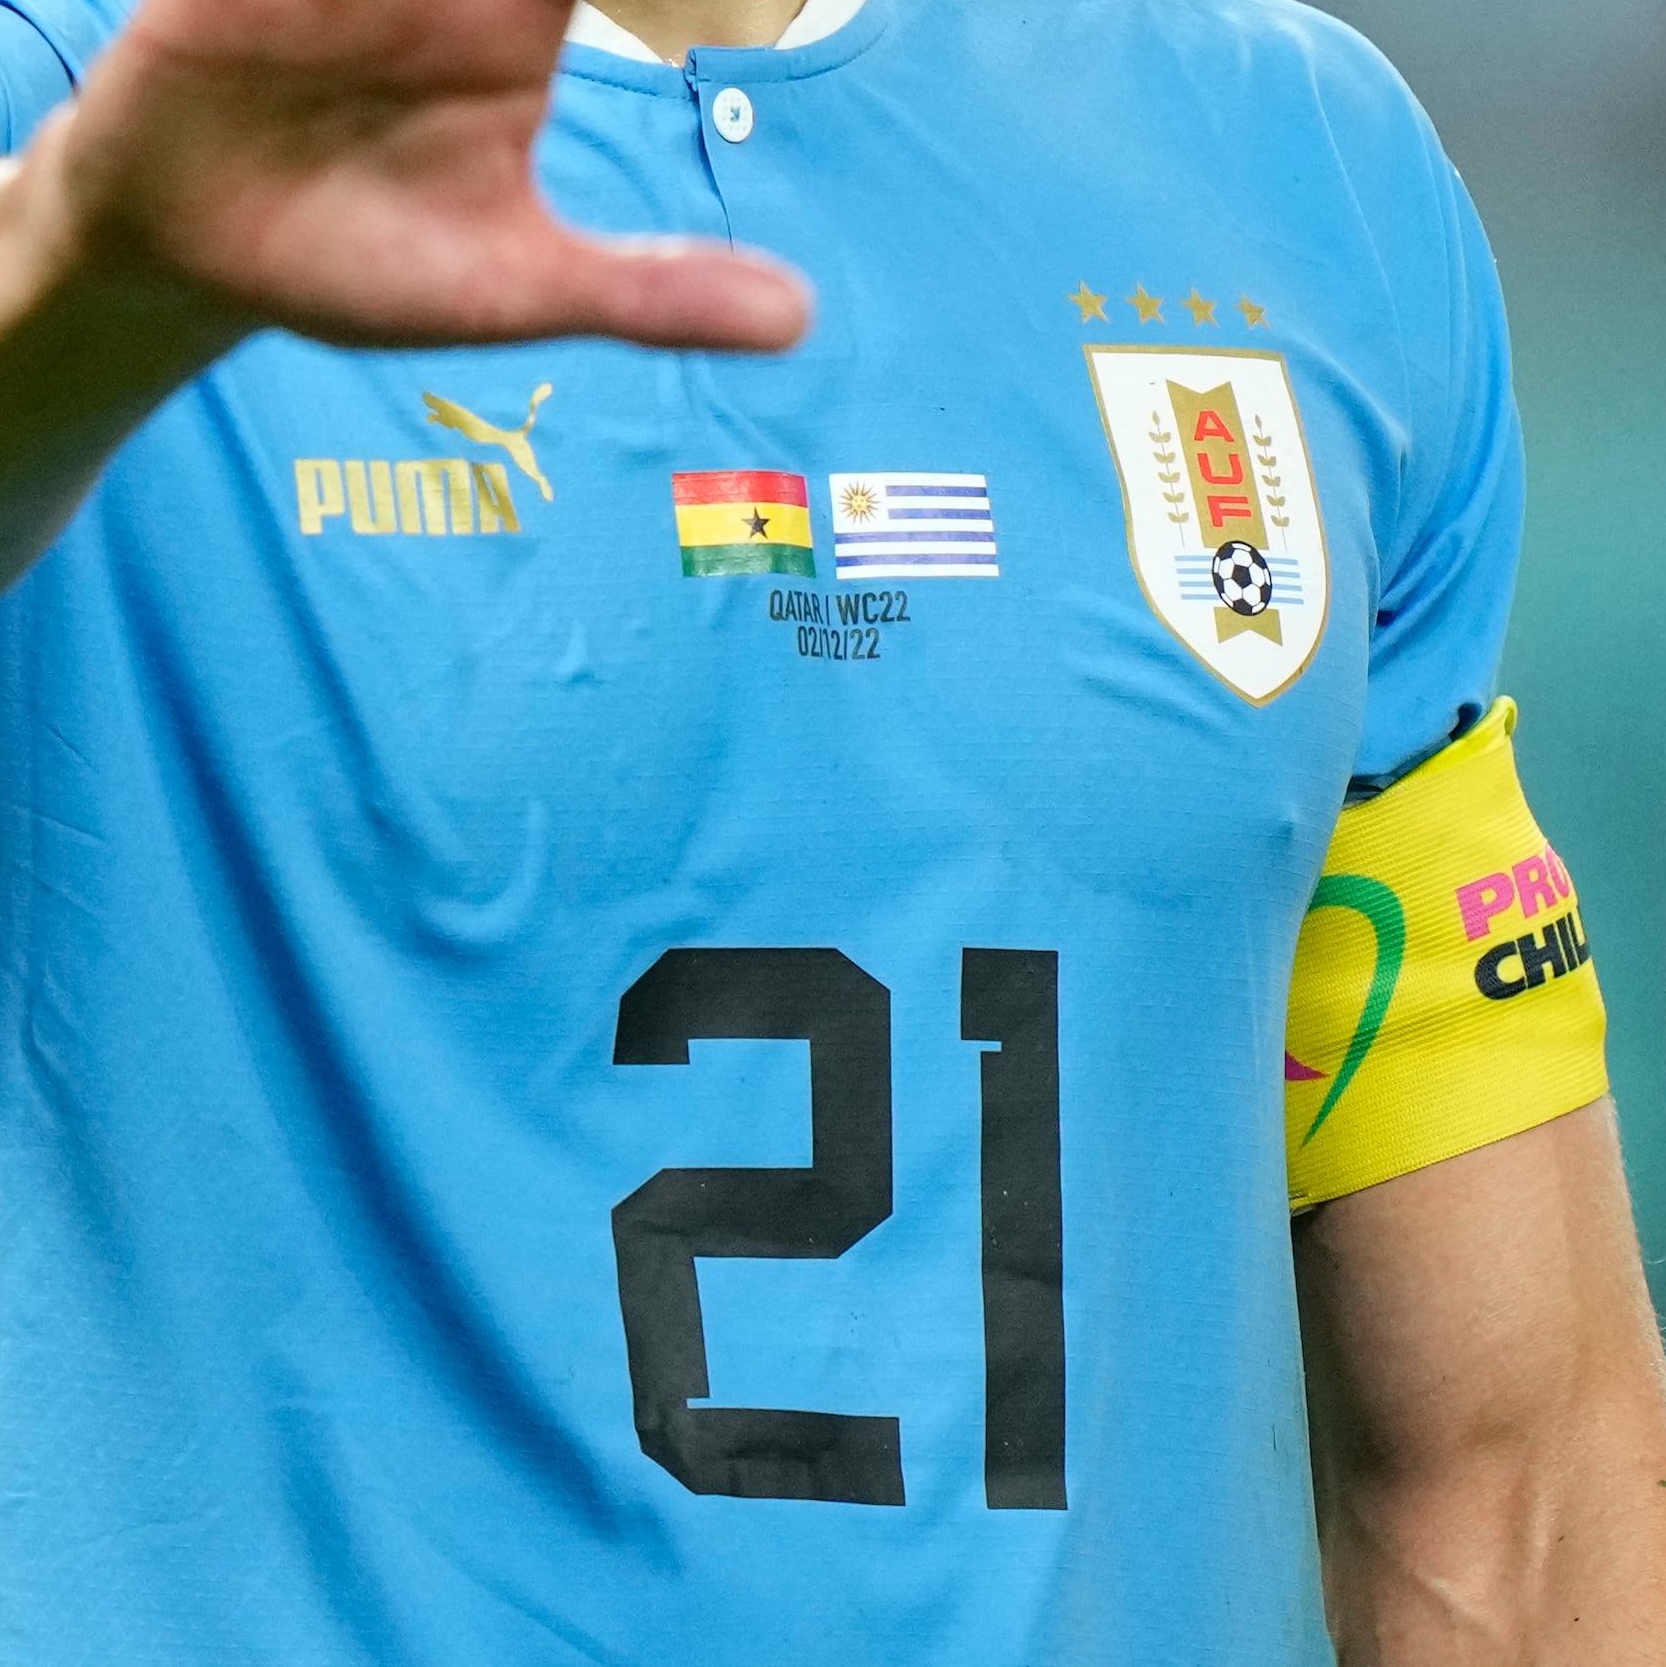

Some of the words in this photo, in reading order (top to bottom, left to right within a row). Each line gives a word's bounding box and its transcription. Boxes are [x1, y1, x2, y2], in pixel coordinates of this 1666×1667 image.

[294, 457, 521, 536] PUMA
[1194, 410, 1252, 528] AUF
[769, 589, 824, 625] QATAR
[835, 590, 911, 626] WC22
[797, 625, 881, 661] 02/12/22
[611, 947, 1068, 1510] 21
